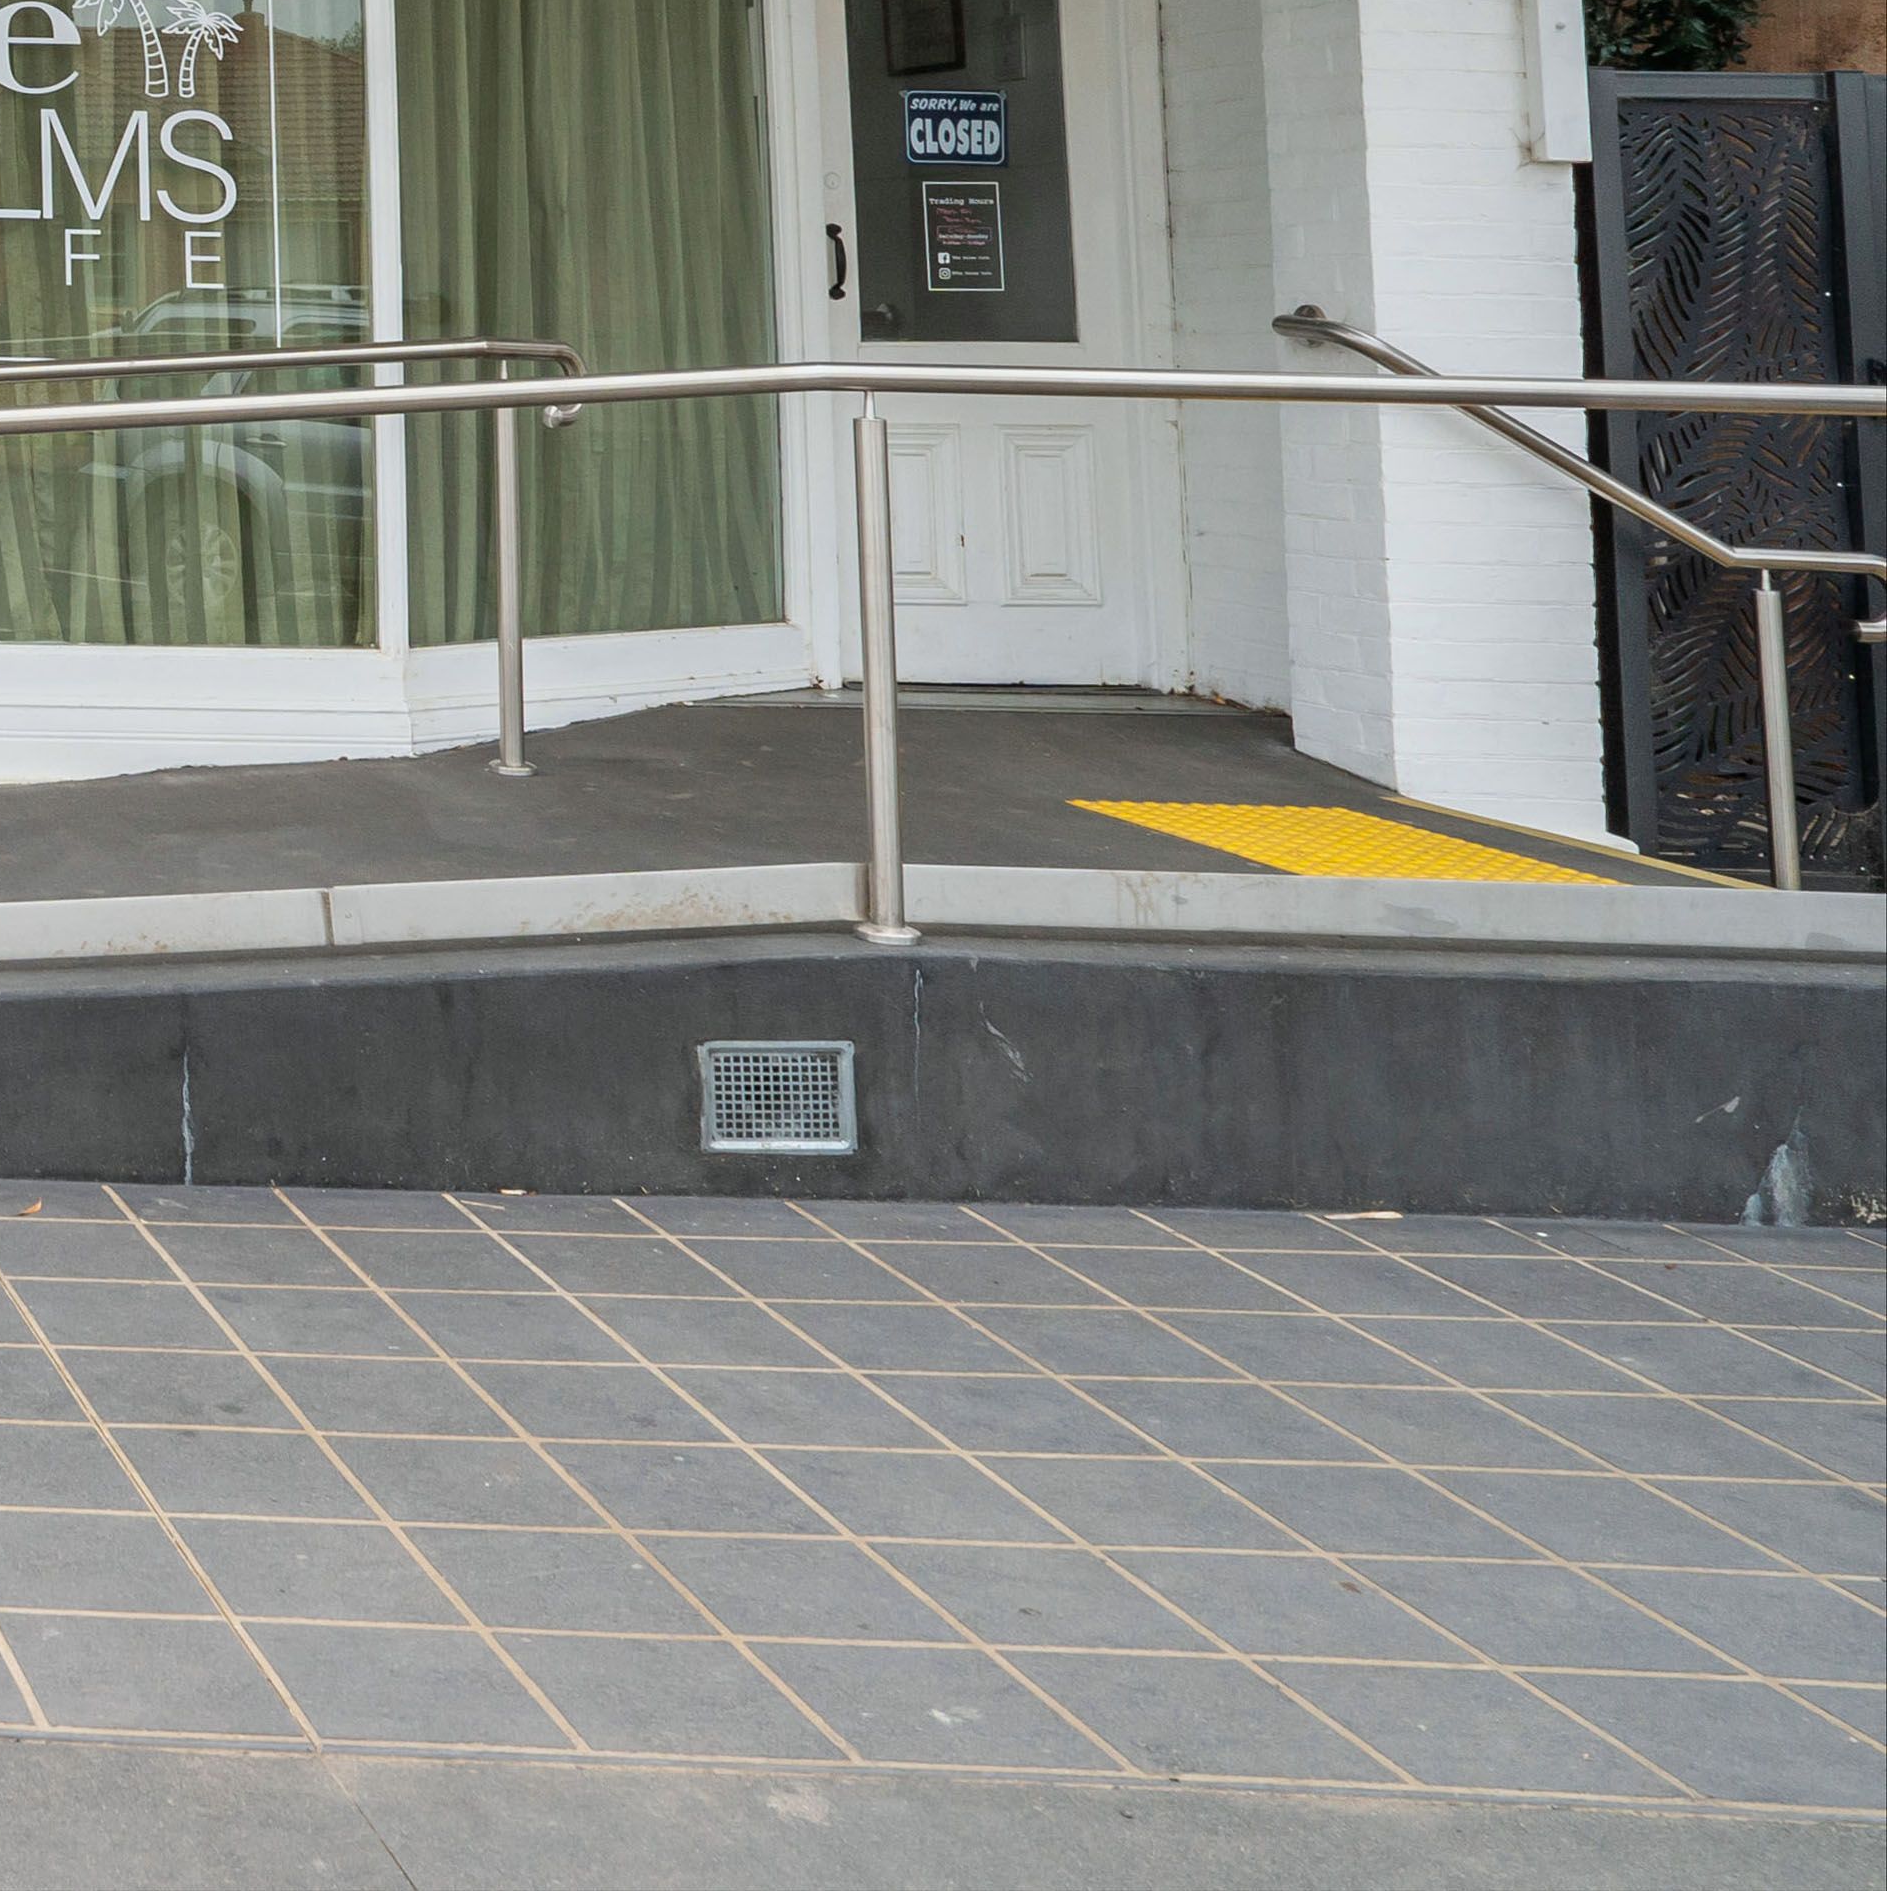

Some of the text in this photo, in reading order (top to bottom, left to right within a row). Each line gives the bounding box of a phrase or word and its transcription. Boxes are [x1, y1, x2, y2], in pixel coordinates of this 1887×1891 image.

[959, 99, 977, 111] We
[979, 102, 1000, 112] are
[910, 117, 1001, 155] CLOSED
